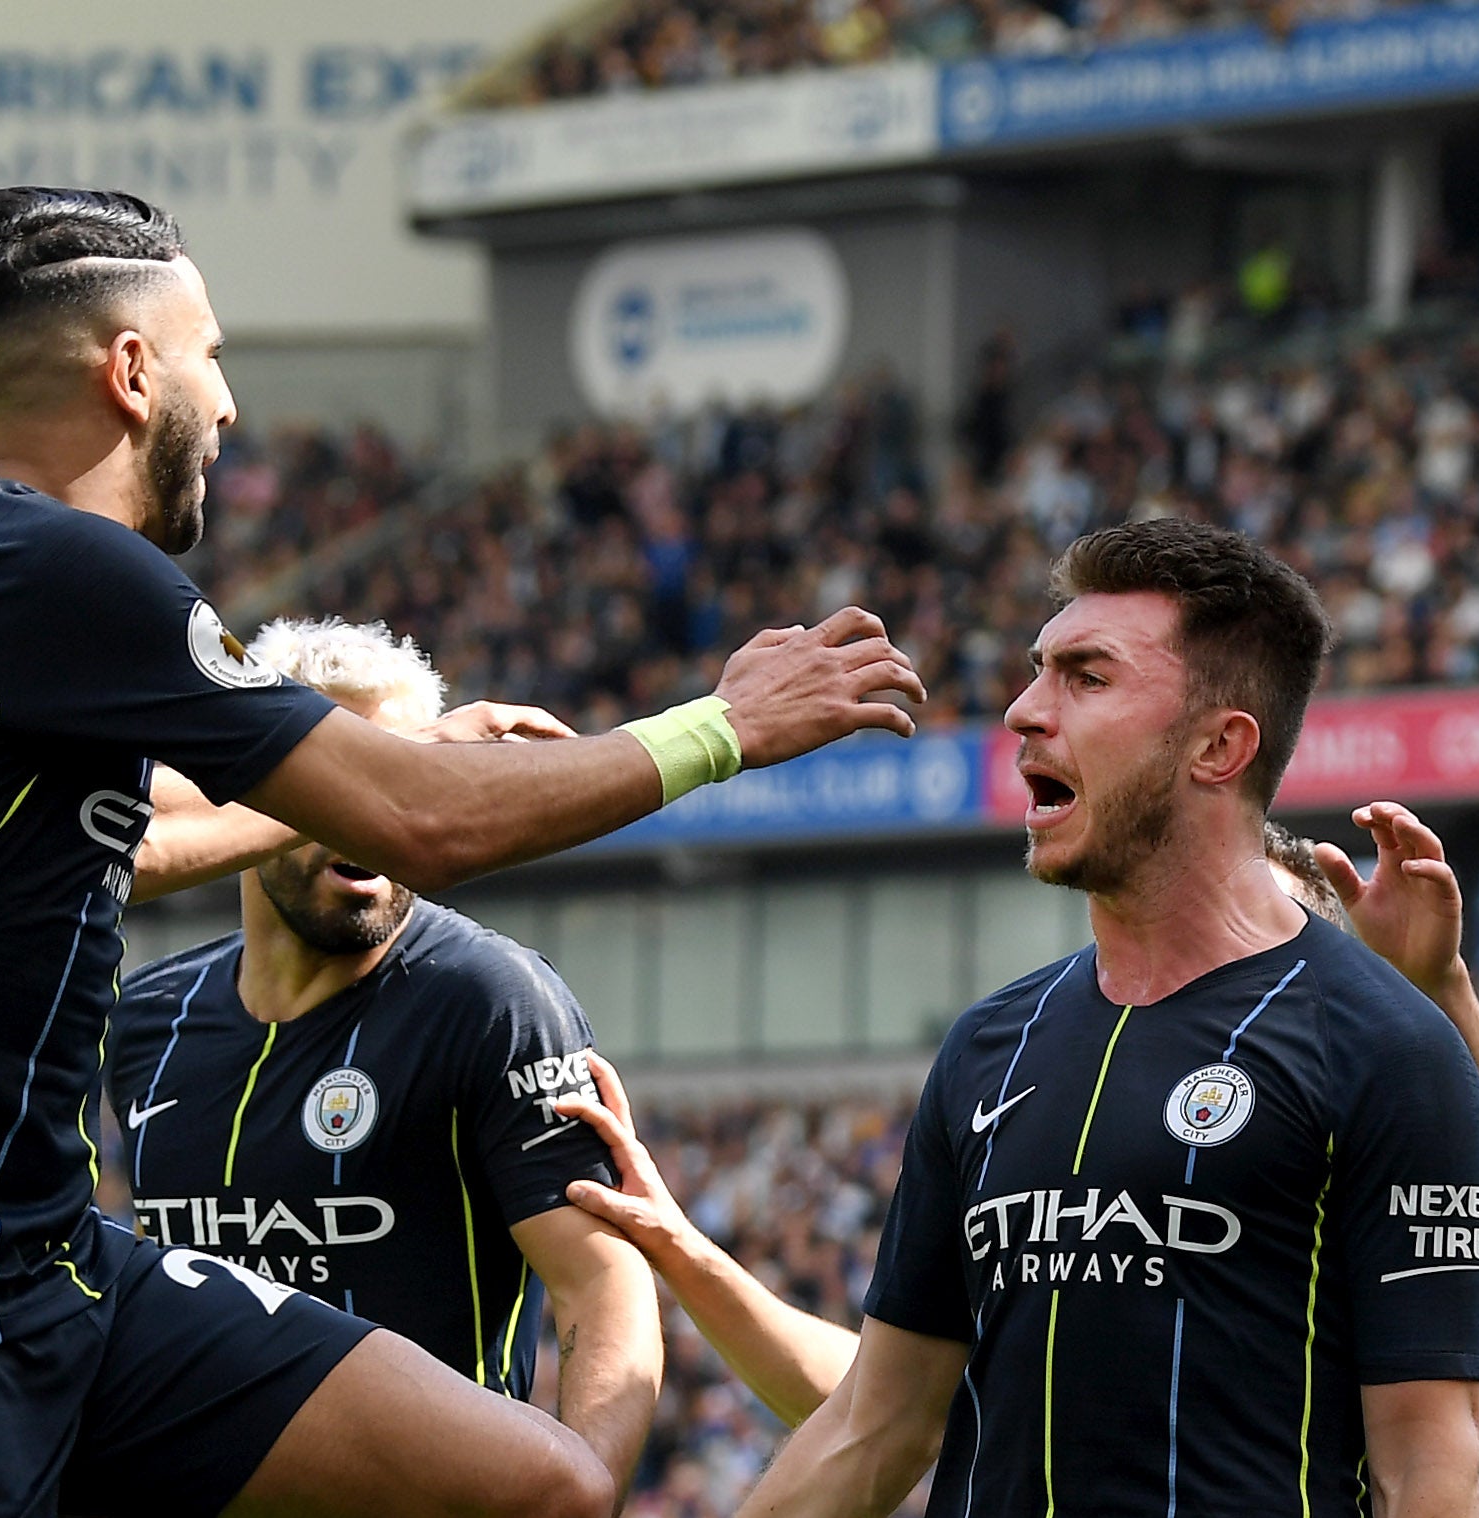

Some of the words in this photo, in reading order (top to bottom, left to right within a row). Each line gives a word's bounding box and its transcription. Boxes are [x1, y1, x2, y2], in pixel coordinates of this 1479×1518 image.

[313, 1072, 371, 1097] MANCHESTER
[507, 1048, 592, 1099] NEXE
[1183, 1068, 1249, 1097] MANCHESTER
[324, 1138, 347, 1146] CITY
[1182, 1128, 1209, 1141] CITY
[964, 1188, 1241, 1261] ETIHAD
